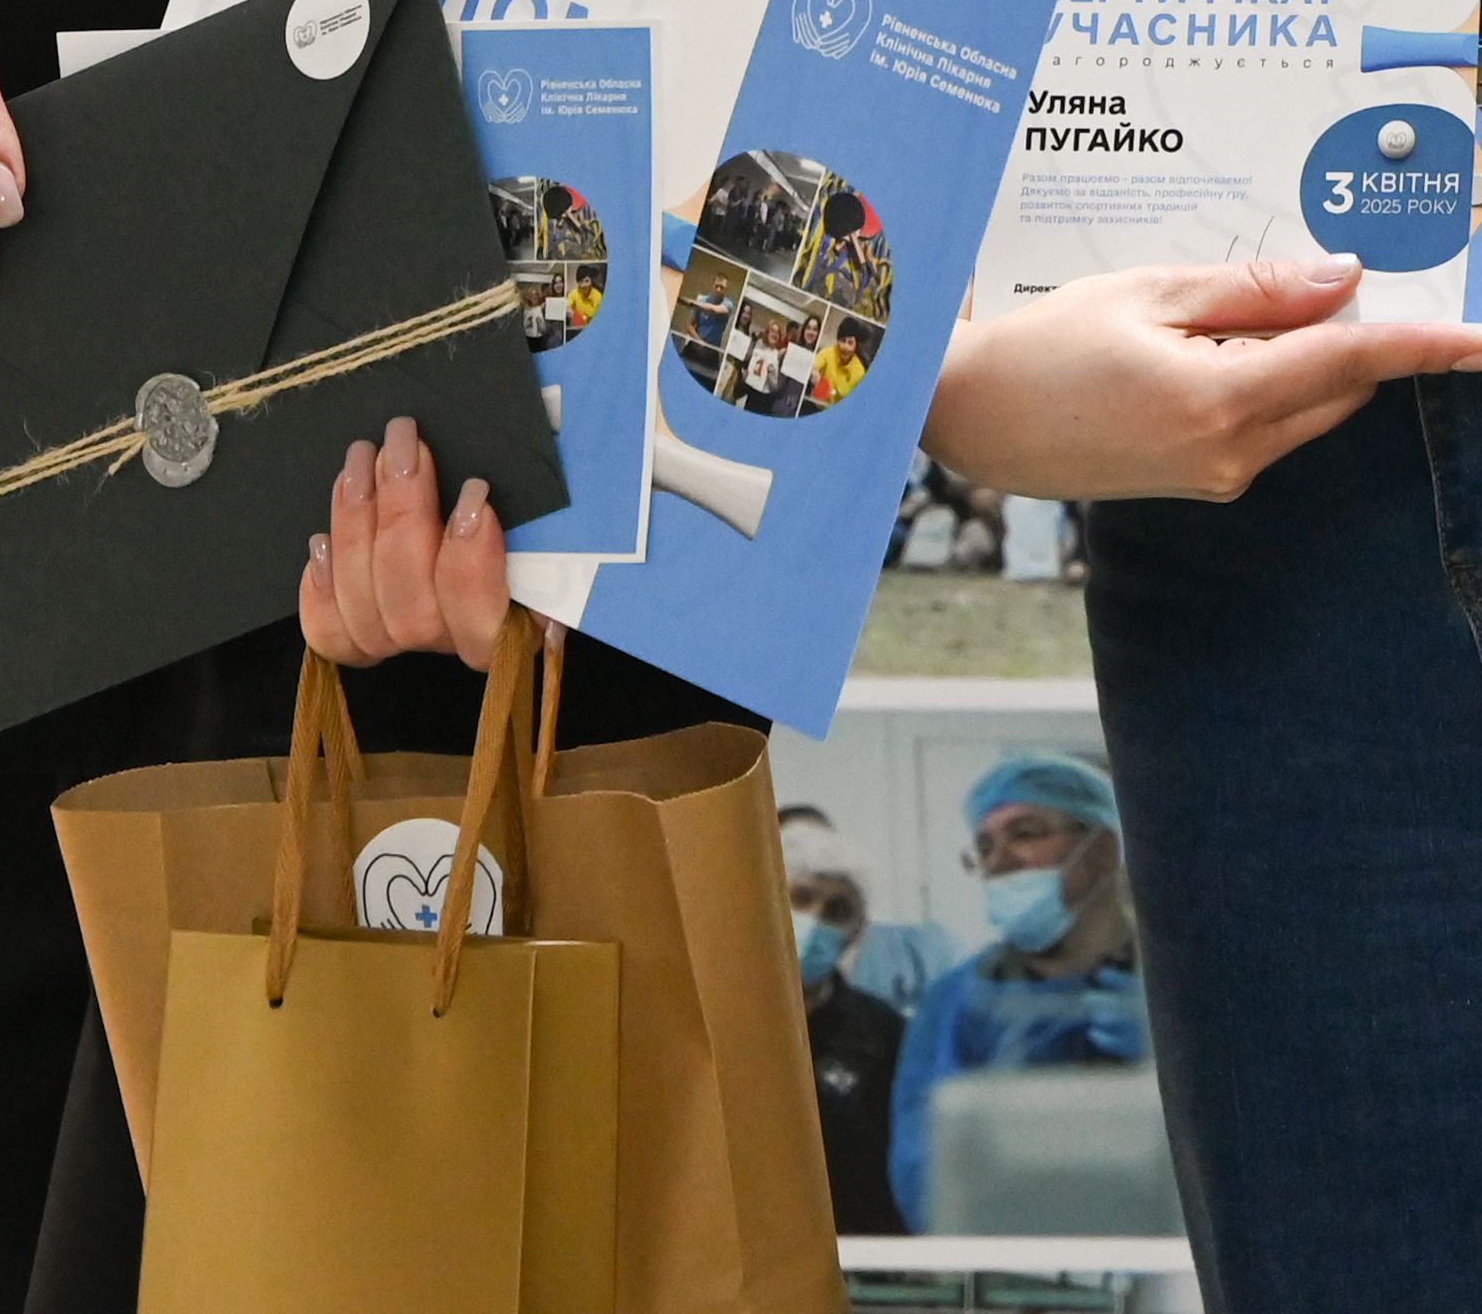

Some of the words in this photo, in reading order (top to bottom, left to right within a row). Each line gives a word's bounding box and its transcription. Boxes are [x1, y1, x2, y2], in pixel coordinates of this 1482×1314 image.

[882, 13, 957, 55] Рівненська
[960, 46, 1018, 80] Обласна
[876, 32, 934, 66] Клінічна
[936, 57, 992, 89] Лікарня
[1052, 55, 1334, 70] агороджується
[892, 59, 926, 83] Юрія
[930, 75, 1000, 114] Семенюка
[1028, 90, 1126, 115] Уляна
[1025, 122, 1184, 153] ПУГАЙКО
[1022, 173, 1057, 184] Разом
[1060, 174, 1119, 185] працюємо
[1131, 175, 1165, 185] разом
[1362, 172, 1459, 194] КВІТНЯ
[1021, 187, 1071, 198] Дякуємо
[1322, 171, 1354, 214] 3
[1020, 201, 1072, 211] розвиток
[1360, 198, 1402, 214] 2025
[1407, 199, 1458, 215] РОКУ
[1034, 214, 1094, 225] підтримку
[1014, 283, 1060, 294] Директ
